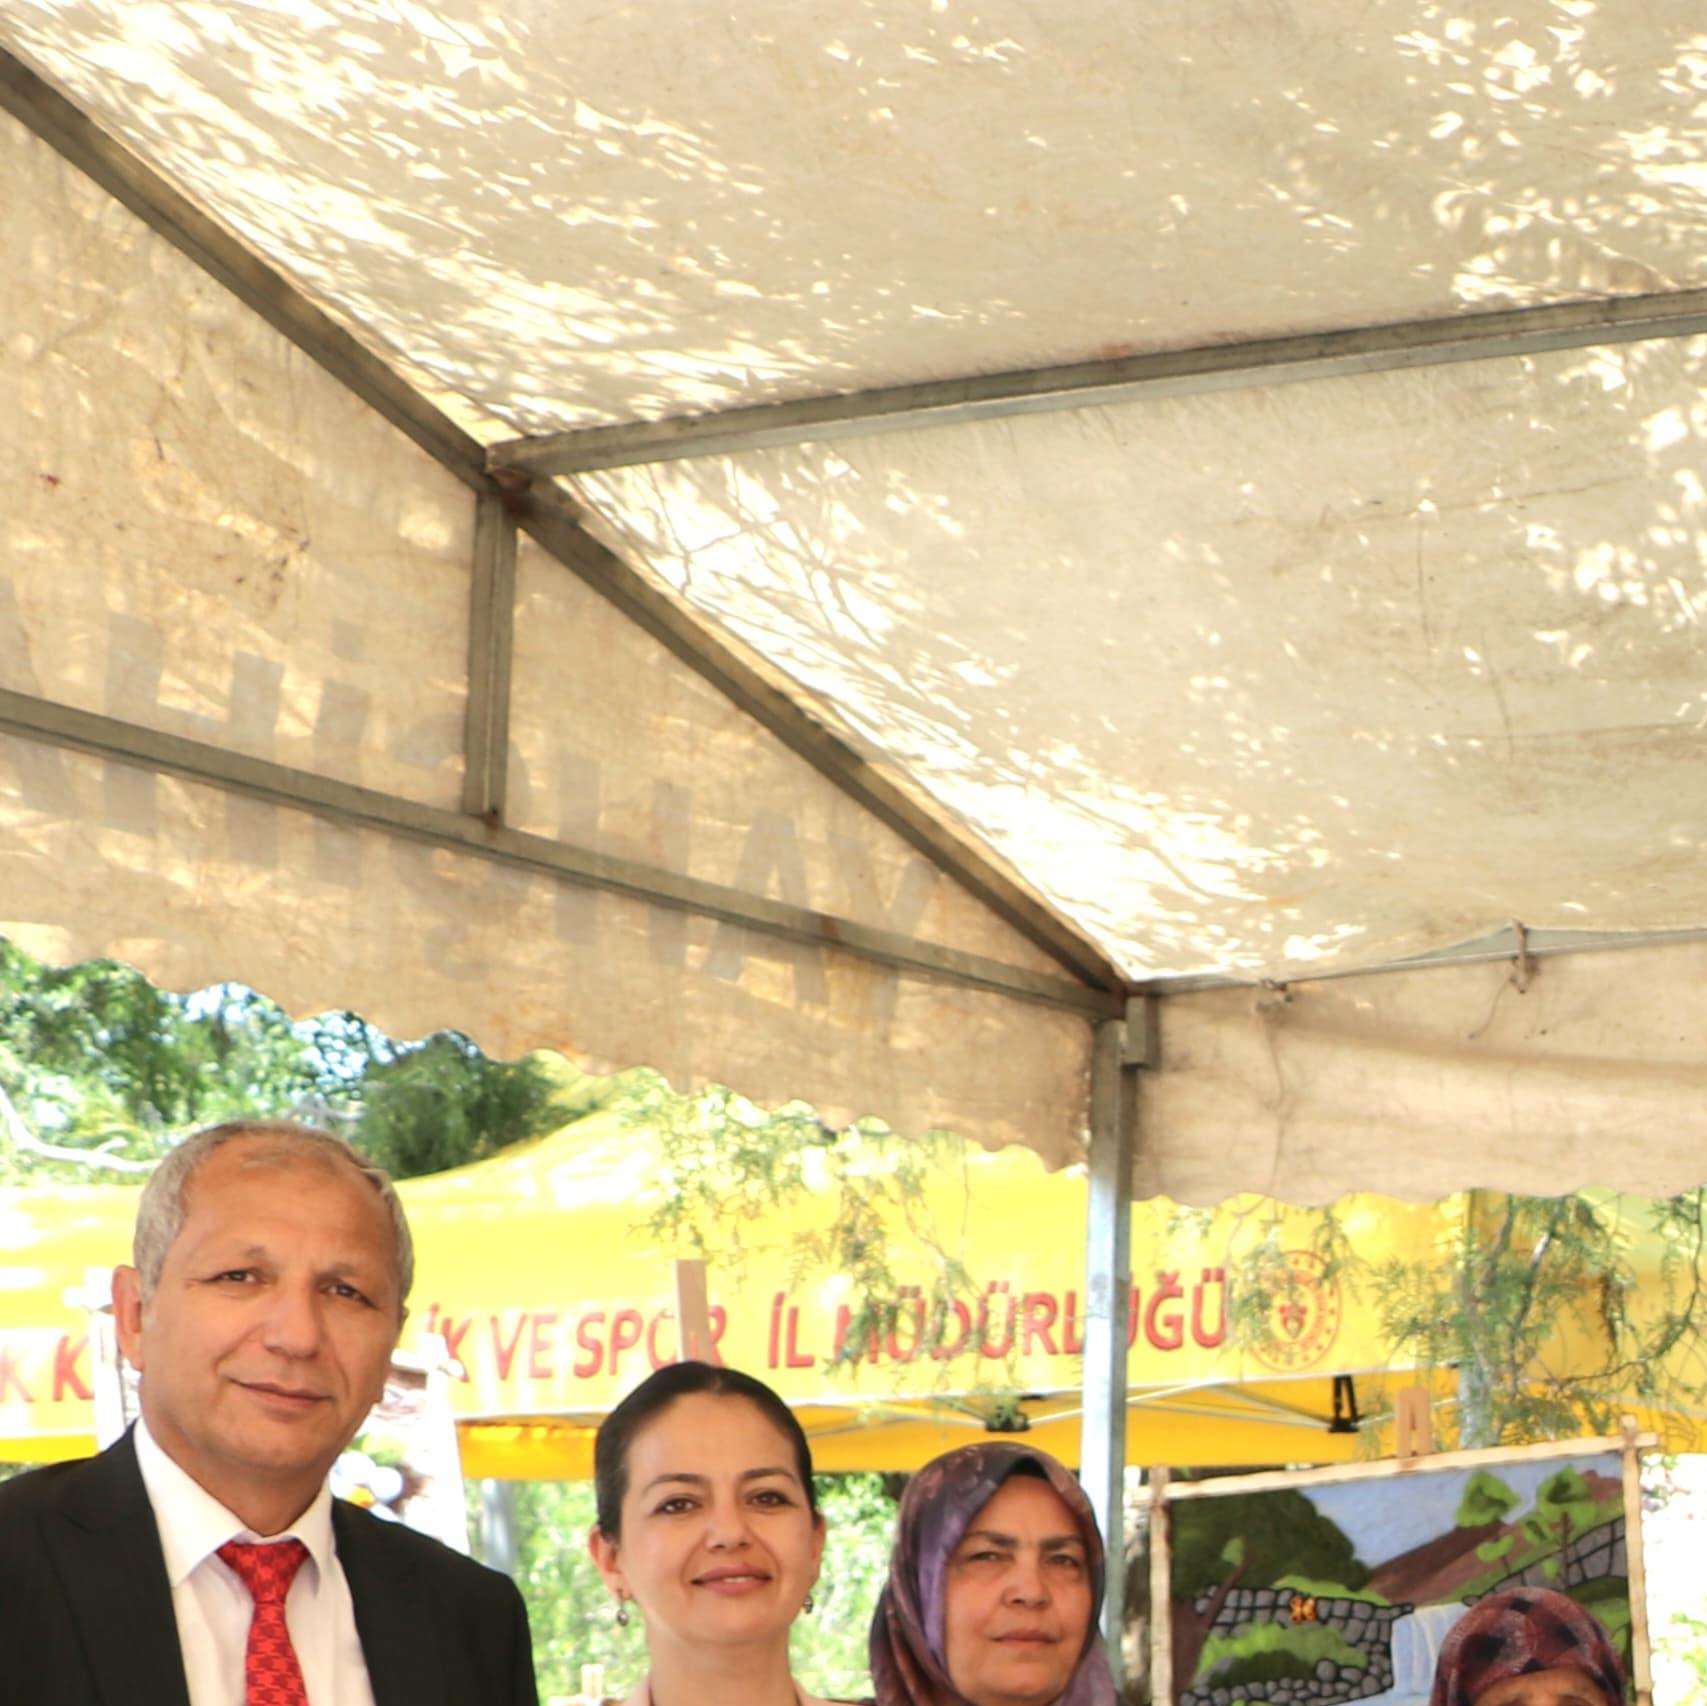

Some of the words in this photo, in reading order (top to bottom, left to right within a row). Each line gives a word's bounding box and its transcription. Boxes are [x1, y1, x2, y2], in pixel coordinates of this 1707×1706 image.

[489, 1312, 557, 1382] VE
[767, 1291, 815, 1370] İL
[832, 1266, 1226, 1366] MÜDÜRLĞÜ
